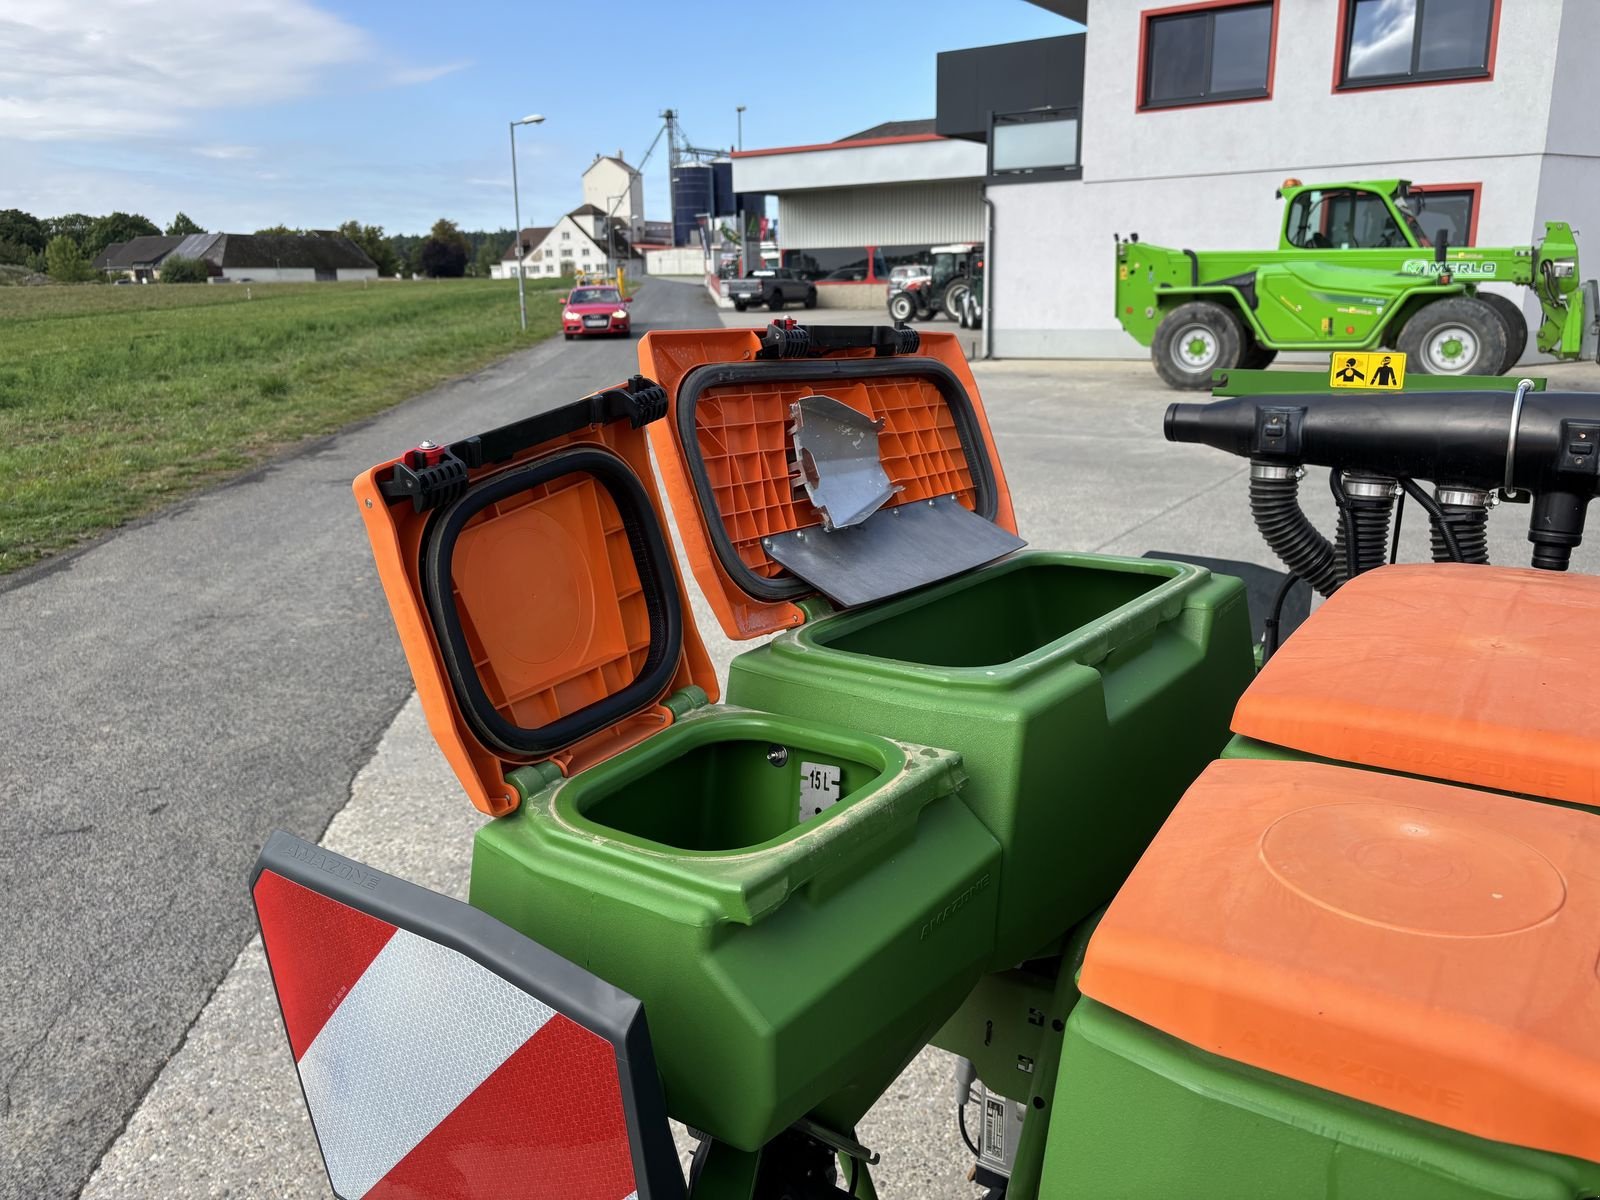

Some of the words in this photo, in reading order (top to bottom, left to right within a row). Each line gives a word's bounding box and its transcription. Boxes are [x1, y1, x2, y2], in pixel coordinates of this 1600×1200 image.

[810, 770, 821, 790] 15
[823, 772, 830, 792] L
[280, 843, 381, 891] AMAZONE
